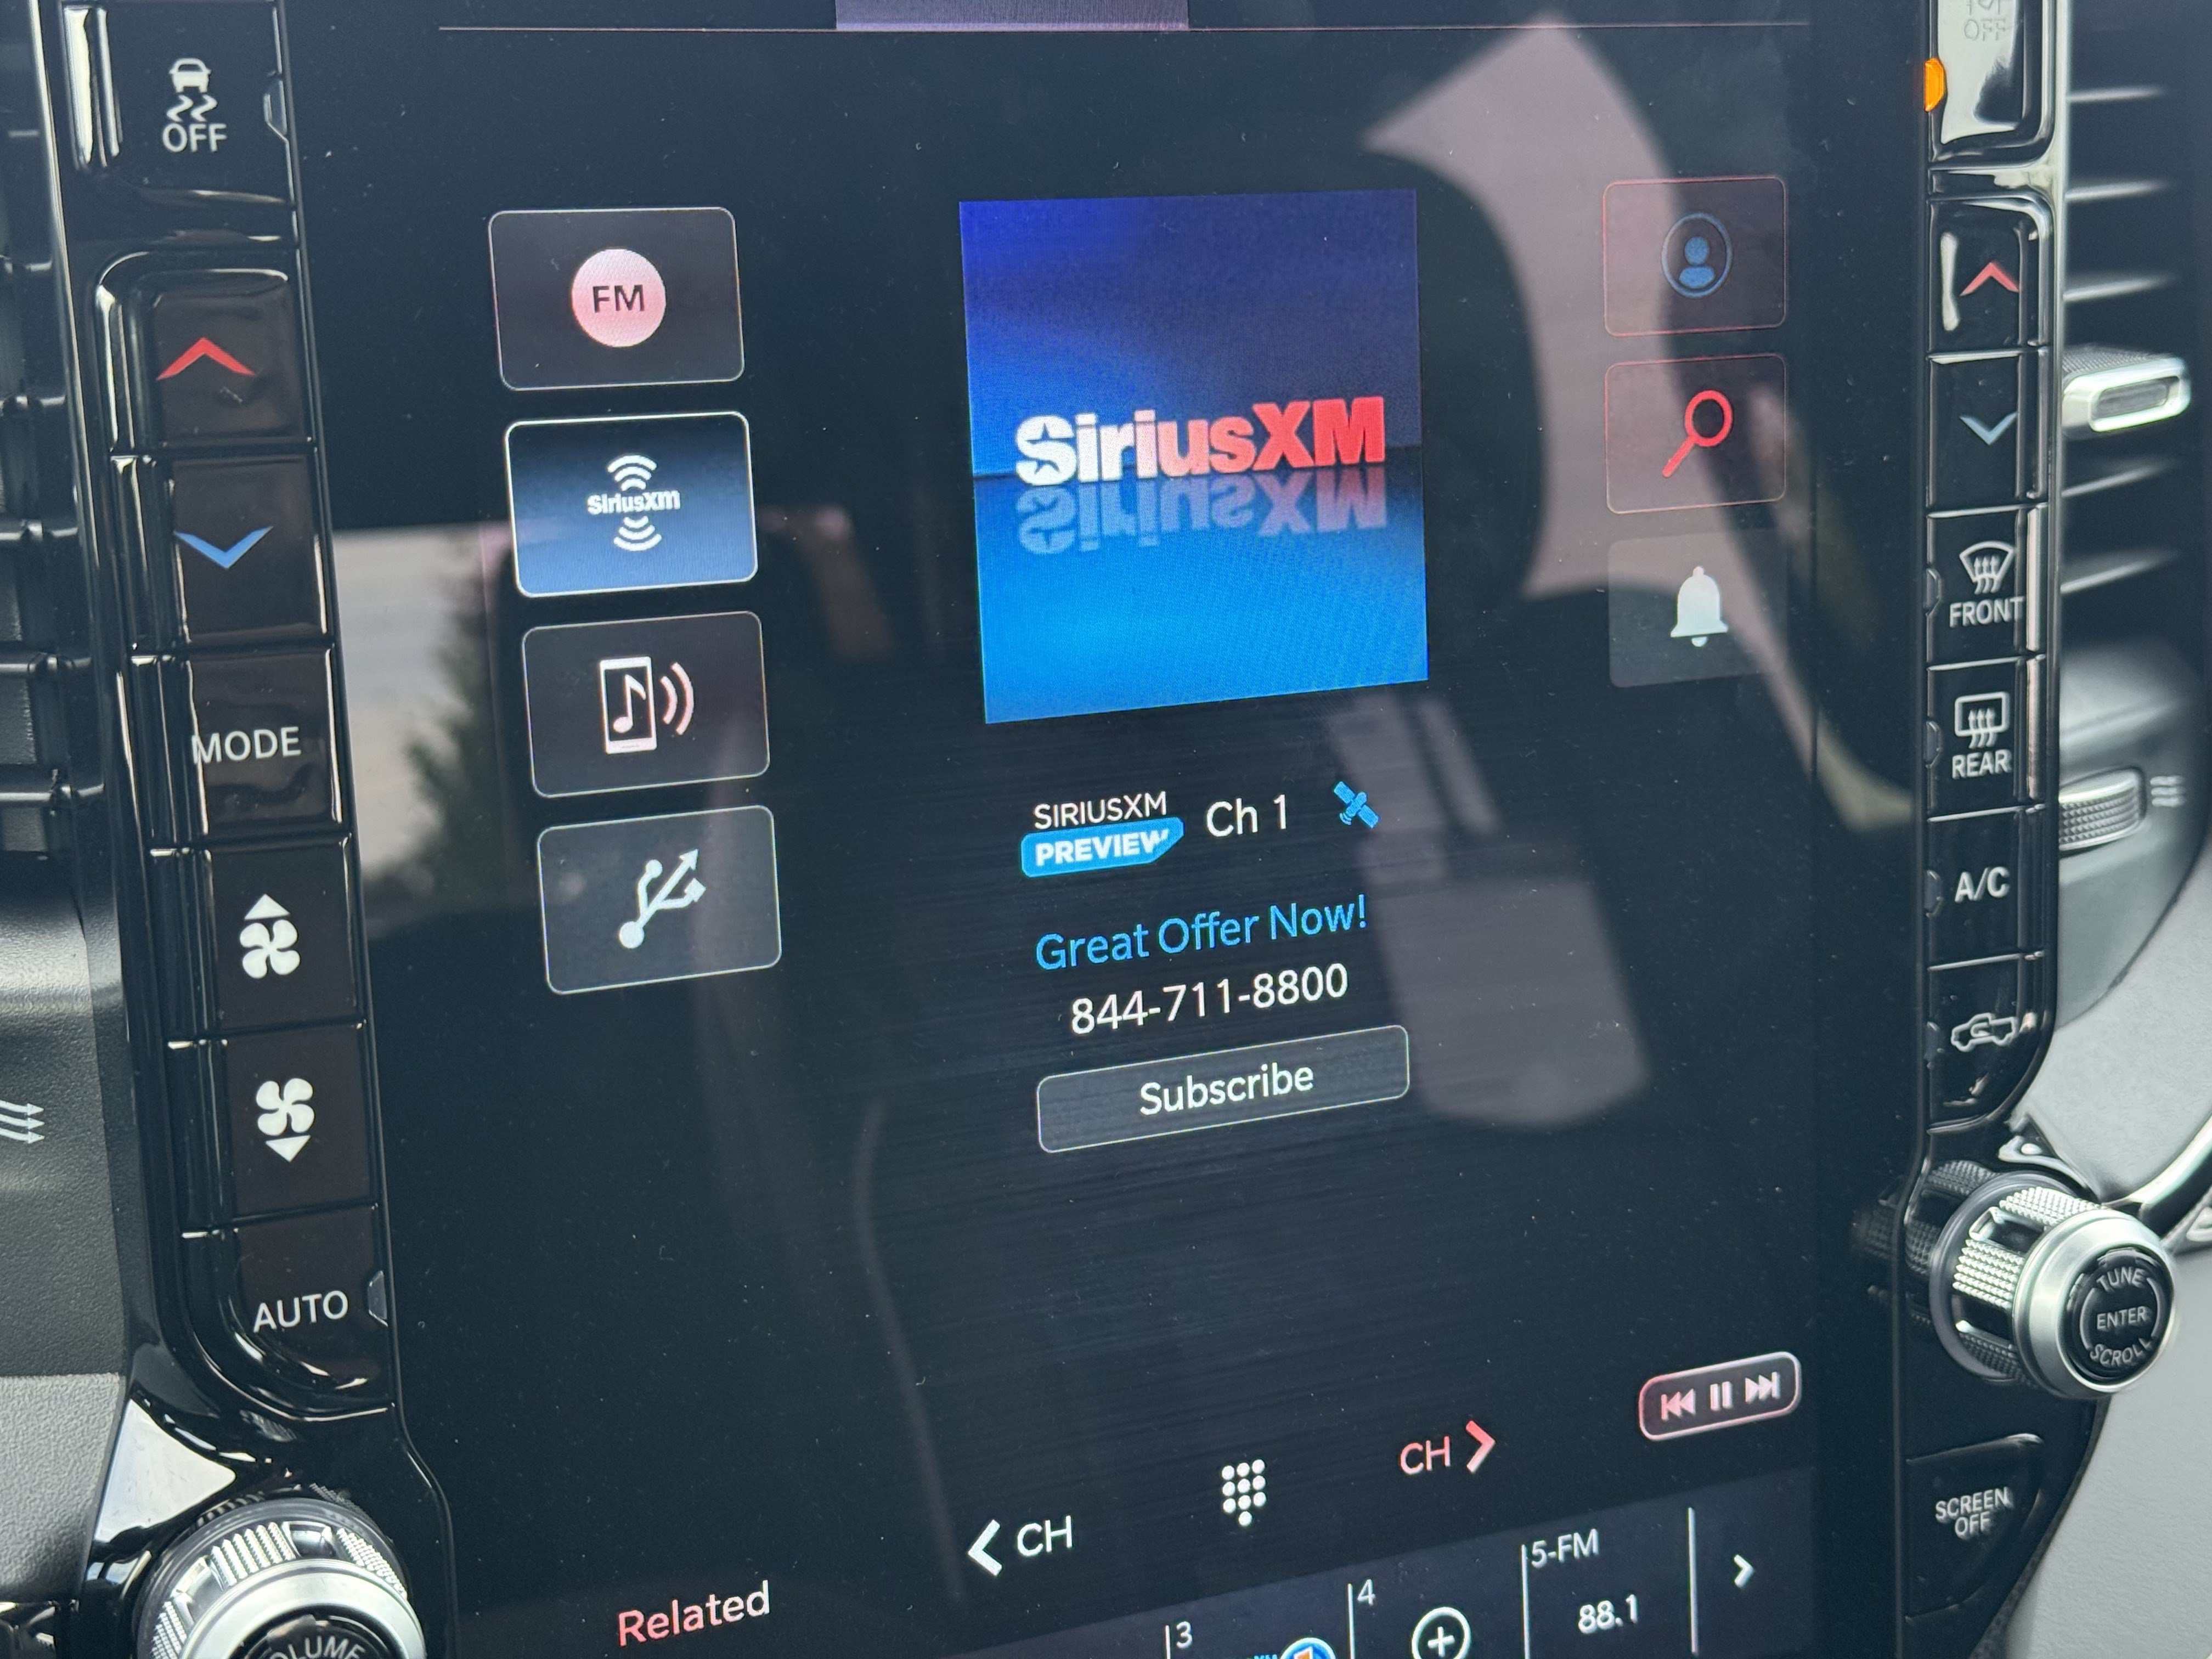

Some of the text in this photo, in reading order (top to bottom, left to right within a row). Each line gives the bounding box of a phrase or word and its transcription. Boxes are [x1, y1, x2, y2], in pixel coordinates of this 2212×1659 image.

[1963, 18, 2006, 42] OFF
[162, 123, 227, 153] OFF
[592, 284, 645, 313] FM
[1015, 396, 1385, 486] SiriusXM
[1949, 596, 2025, 628] FRONT
[191, 726, 302, 764] MODE
[1952, 749, 2012, 779] REAR
[1034, 791, 1167, 830] SIRIUSXM
[1206, 794, 1288, 837] Ch 1
[1035, 828, 1169, 867] PREVIEW
[1955, 867, 2010, 902] A/C
[1035, 893, 1368, 971] Great Offer Now!
[1070, 962, 1349, 1035] 844-711-8800
[1139, 1062, 1314, 1116] Subscribe
[2096, 1266, 2146, 1294] TUNE
[253, 1290, 348, 1333] AUTO
[2097, 1306, 2151, 1331] ENTER
[2089, 1338, 2152, 1367] SCROLL
[1400, 1436, 1451, 1475] CH
[1935, 1486, 2013, 1523] SCREEN
[1016, 1515, 1074, 1557] CH
[1955, 1511, 1991, 1539] OFF
[1531, 1528, 1599, 1568] 5-FM
[1358, 1579, 1375, 1605] 4
[618, 1579, 770, 1646] Related
[1578, 1594, 1638, 1634] 88.1
[1176, 1621, 1193, 1649] 3
